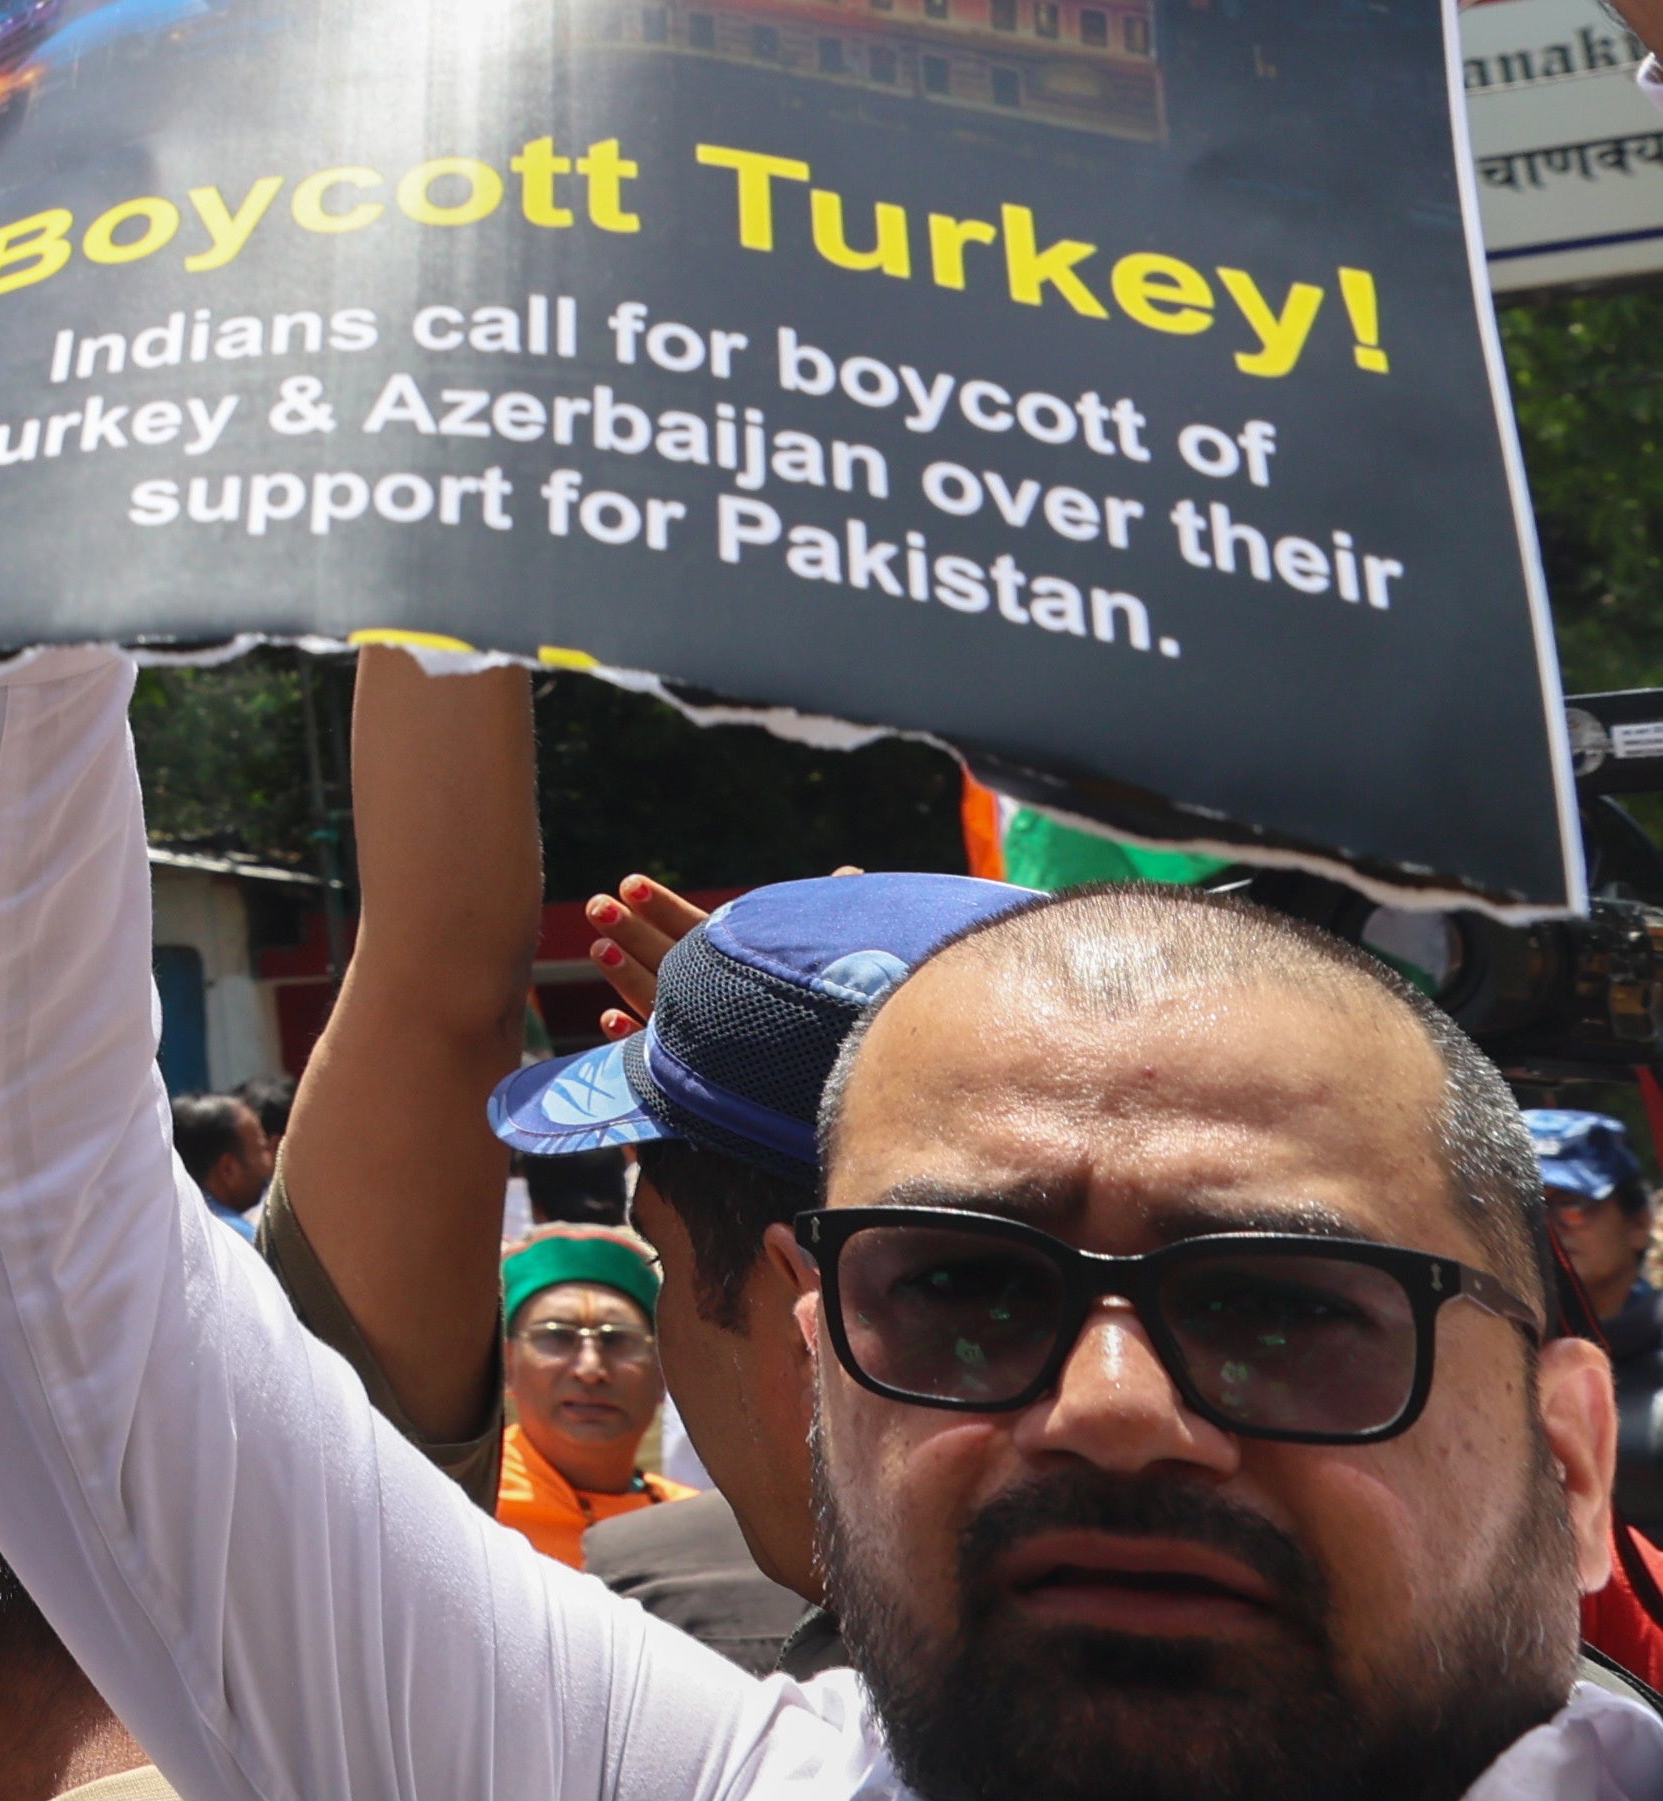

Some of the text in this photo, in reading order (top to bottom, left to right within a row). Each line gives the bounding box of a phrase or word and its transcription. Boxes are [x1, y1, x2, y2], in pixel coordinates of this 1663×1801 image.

[695, 143, 1390, 378] Turkey!
[49, 294, 1277, 487] Indians call for boycott of
[268, 374, 338, 434] &
[361, 371, 889, 499] Azerbaijan
[921, 460, 1145, 551] over
[1170, 498, 1404, 611] their
[127, 466, 1181, 658] support for Pakistan.
